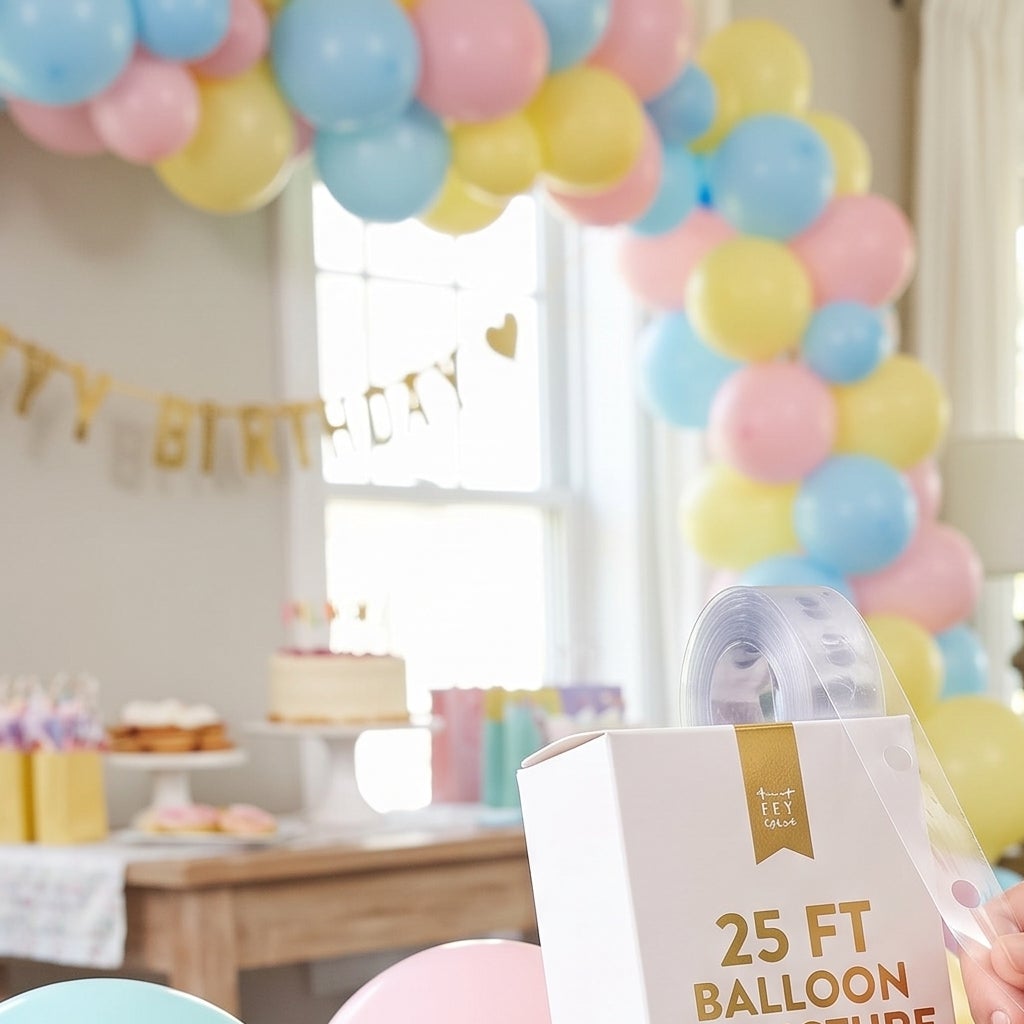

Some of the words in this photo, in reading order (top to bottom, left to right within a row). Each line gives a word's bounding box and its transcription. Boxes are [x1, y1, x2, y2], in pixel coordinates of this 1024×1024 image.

[153, 349, 464, 476] BIRTHDAY
[715, 909, 789, 967] 25
[805, 900, 871, 958] FT
[694, 962, 909, 1022] BALLOON
